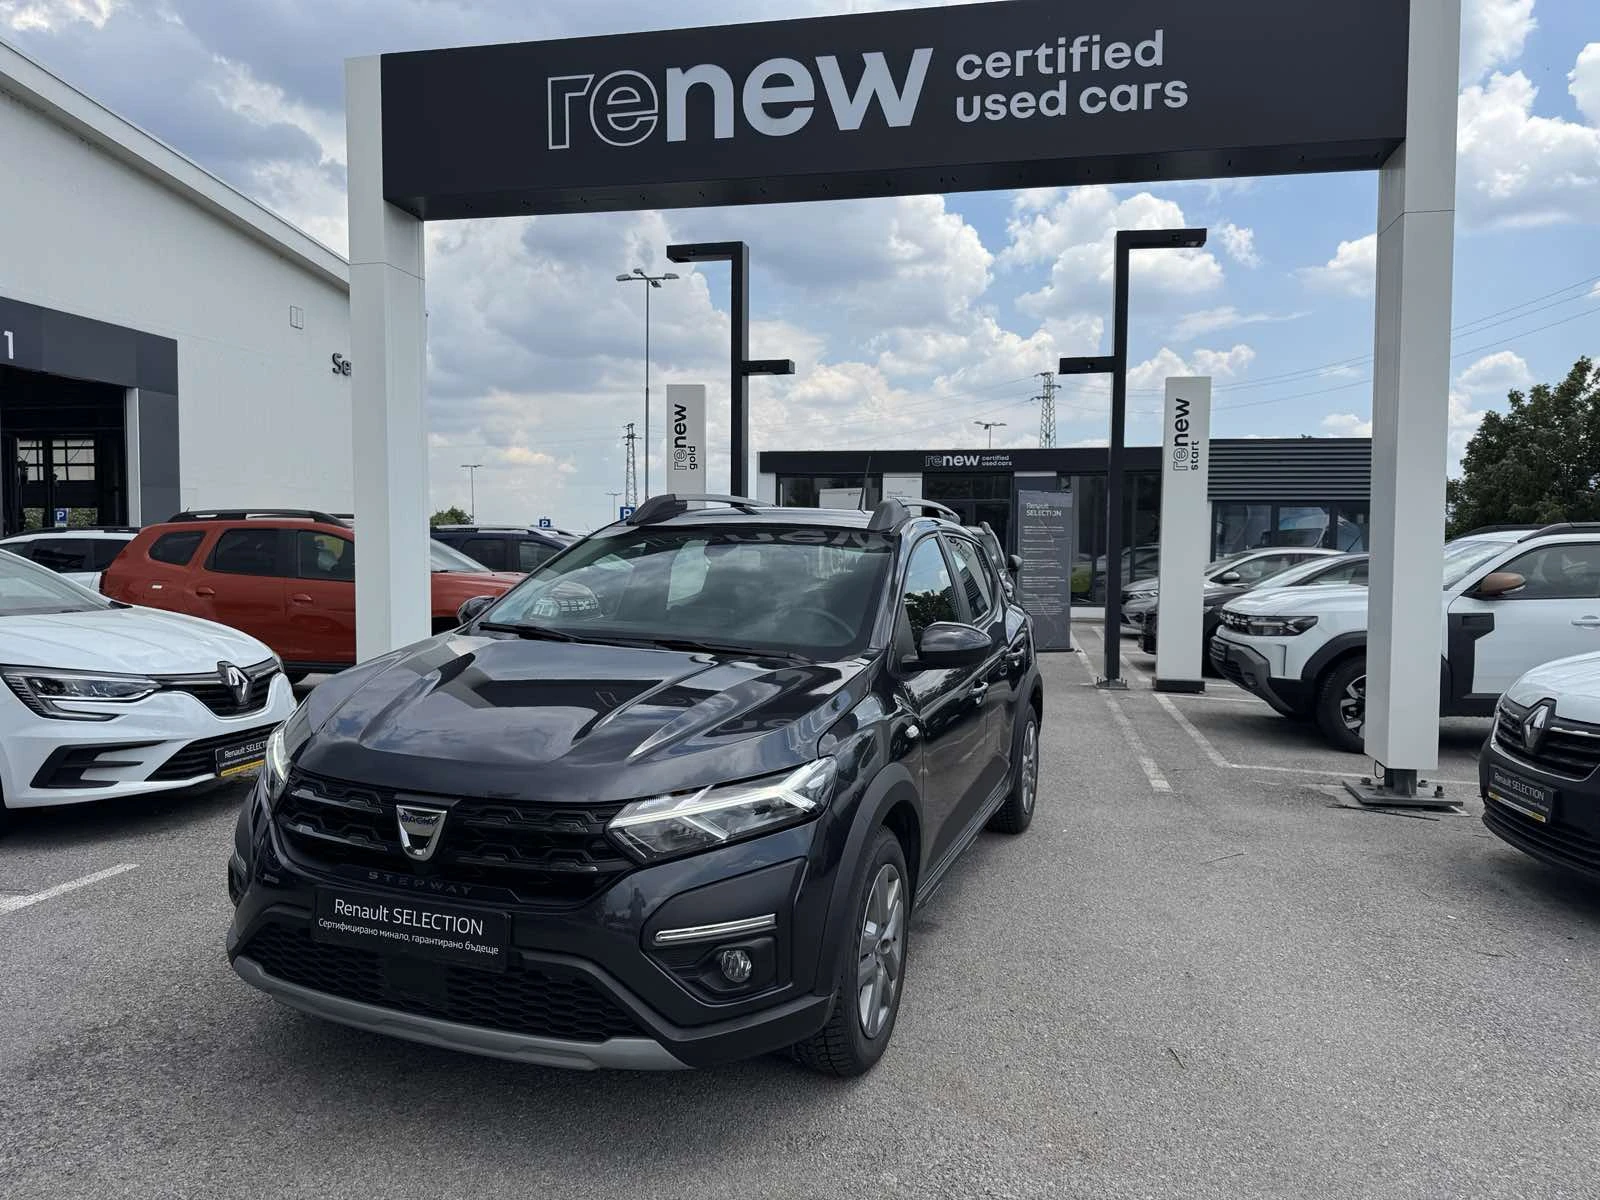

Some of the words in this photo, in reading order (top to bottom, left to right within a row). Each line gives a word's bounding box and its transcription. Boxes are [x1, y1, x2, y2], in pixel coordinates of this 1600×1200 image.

[955, 28, 1164, 81] certified
[547, 47, 934, 150] renew
[955, 79, 1067, 123] used
[1079, 80, 1189, 114] cars
[331, 352, 352, 376] Se
[673, 403, 688, 471] renew
[1172, 397, 1190, 472] renew
[687, 445, 698, 470] gold
[924, 454, 980, 467] renew
[1190, 440, 1200, 471] start
[56, 511, 65, 521] P
[623, 508, 632, 520] P
[1026, 509, 1063, 517] SELECTION
[224, 746, 245, 759] Renault
[246, 740, 267, 753] SELECT
[1511, 780, 1545, 801] SELECTION
[367, 870, 474, 896] STEPWAY
[334, 898, 390, 923] Renault
[392, 908, 484, 936] SELECTION
[318, 917, 379, 936] Сертифицирано
[379, 929, 411, 943] минало,
[411, 935, 464, 949] гарантирано
[464, 941, 499, 956] бъдеще
